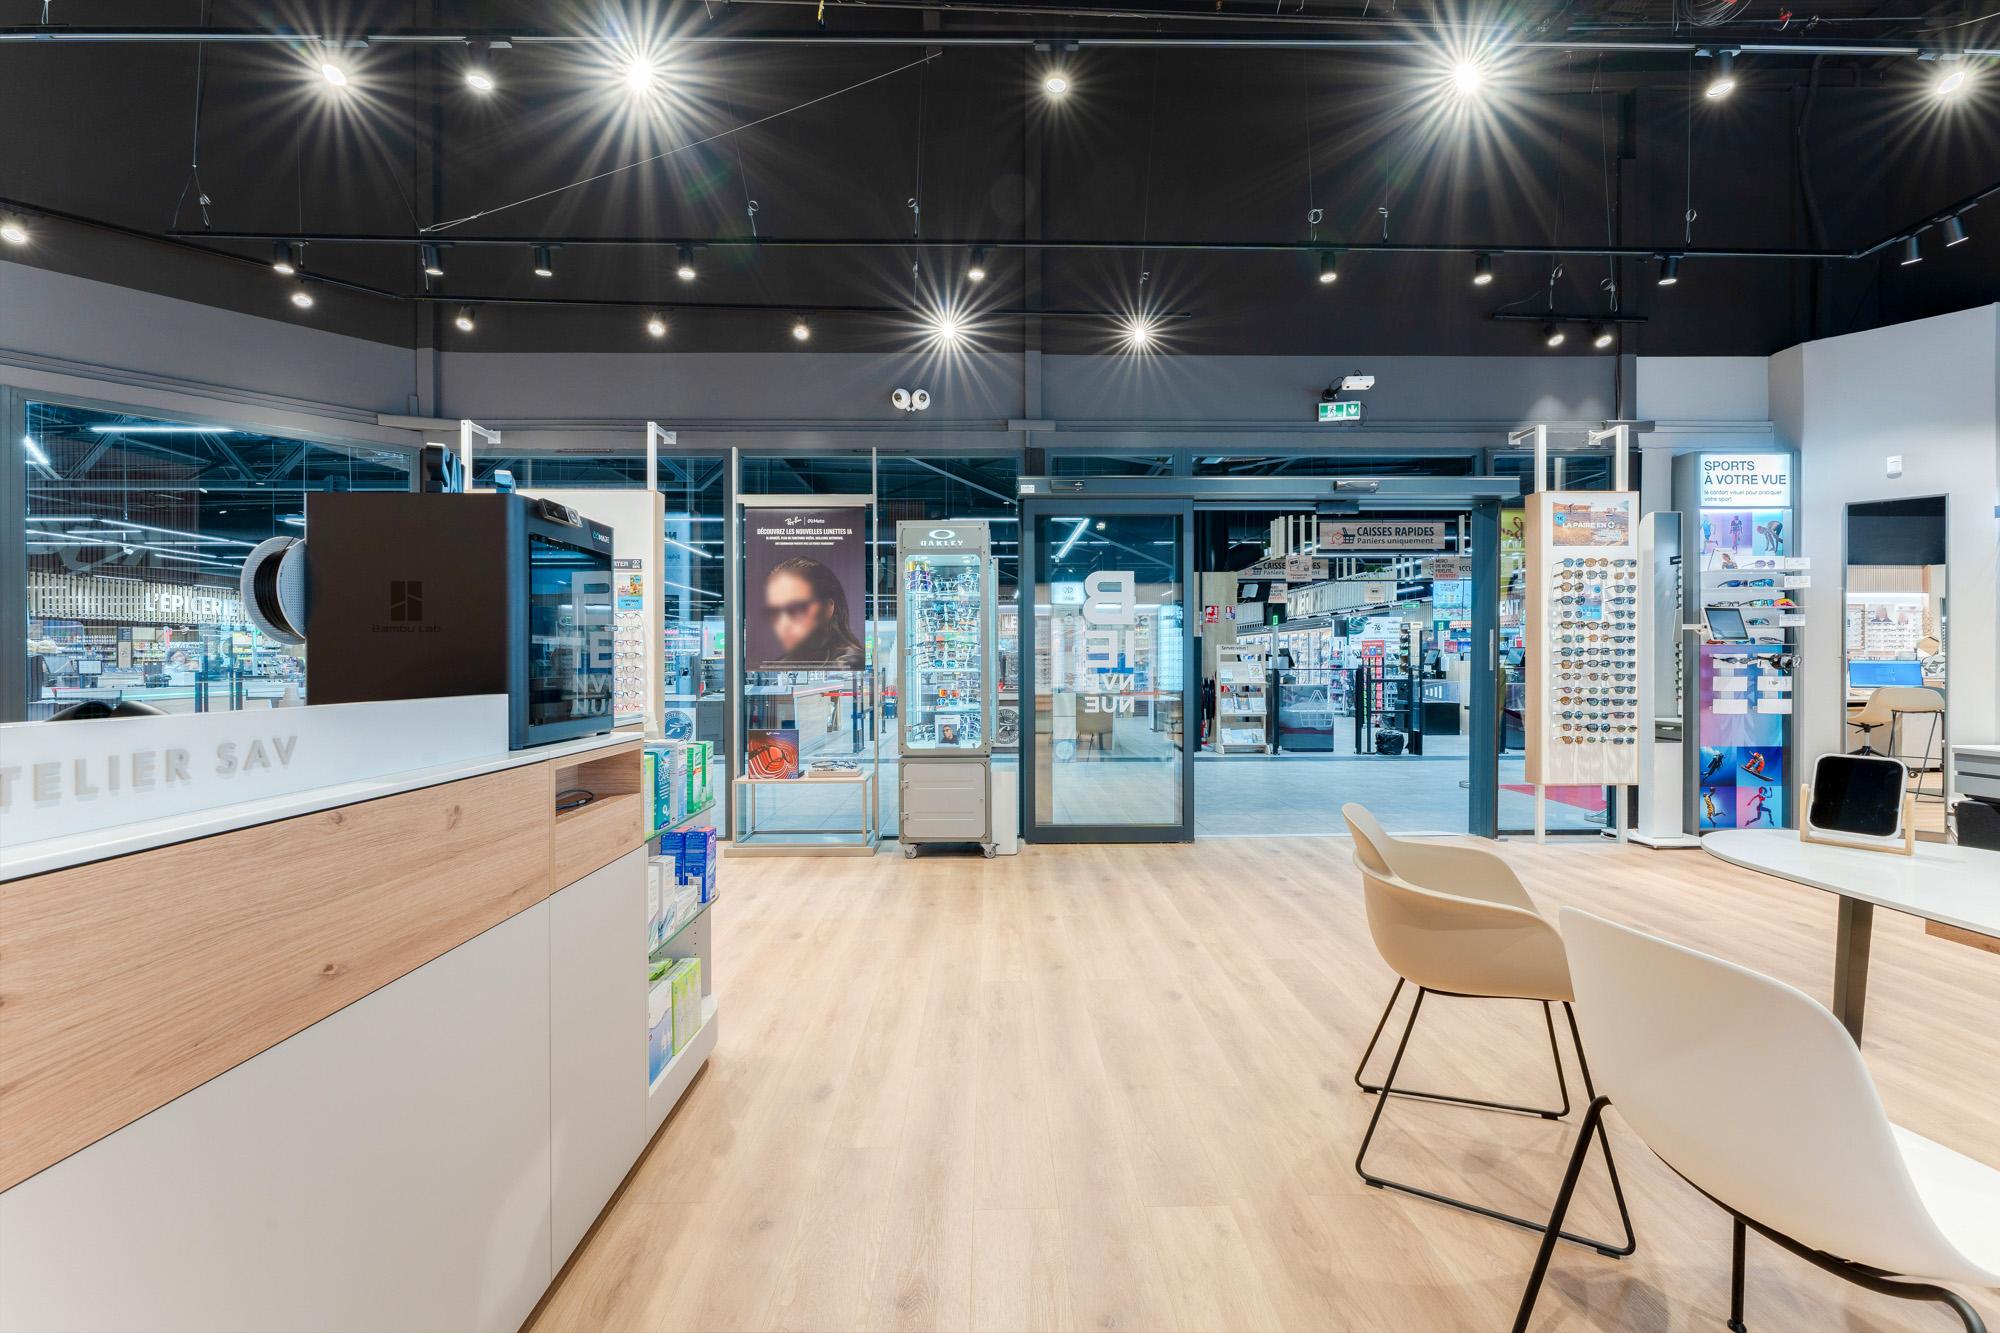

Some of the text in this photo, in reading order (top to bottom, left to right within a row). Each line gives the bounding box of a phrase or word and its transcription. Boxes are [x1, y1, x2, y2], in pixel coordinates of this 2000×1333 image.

[1704, 460, 1755, 471] SPORTS
[1704, 472, 1787, 485] À VOTRE VUE
[1356, 526, 1434, 536] CAISSES RAPIDES
[1387, 537, 1434, 546] uniquement
[145, 592, 240, 617] L'ÉPICERIE
[372, 623, 441, 633] Bambu Lab
[215, 735, 298, 776] SAV
